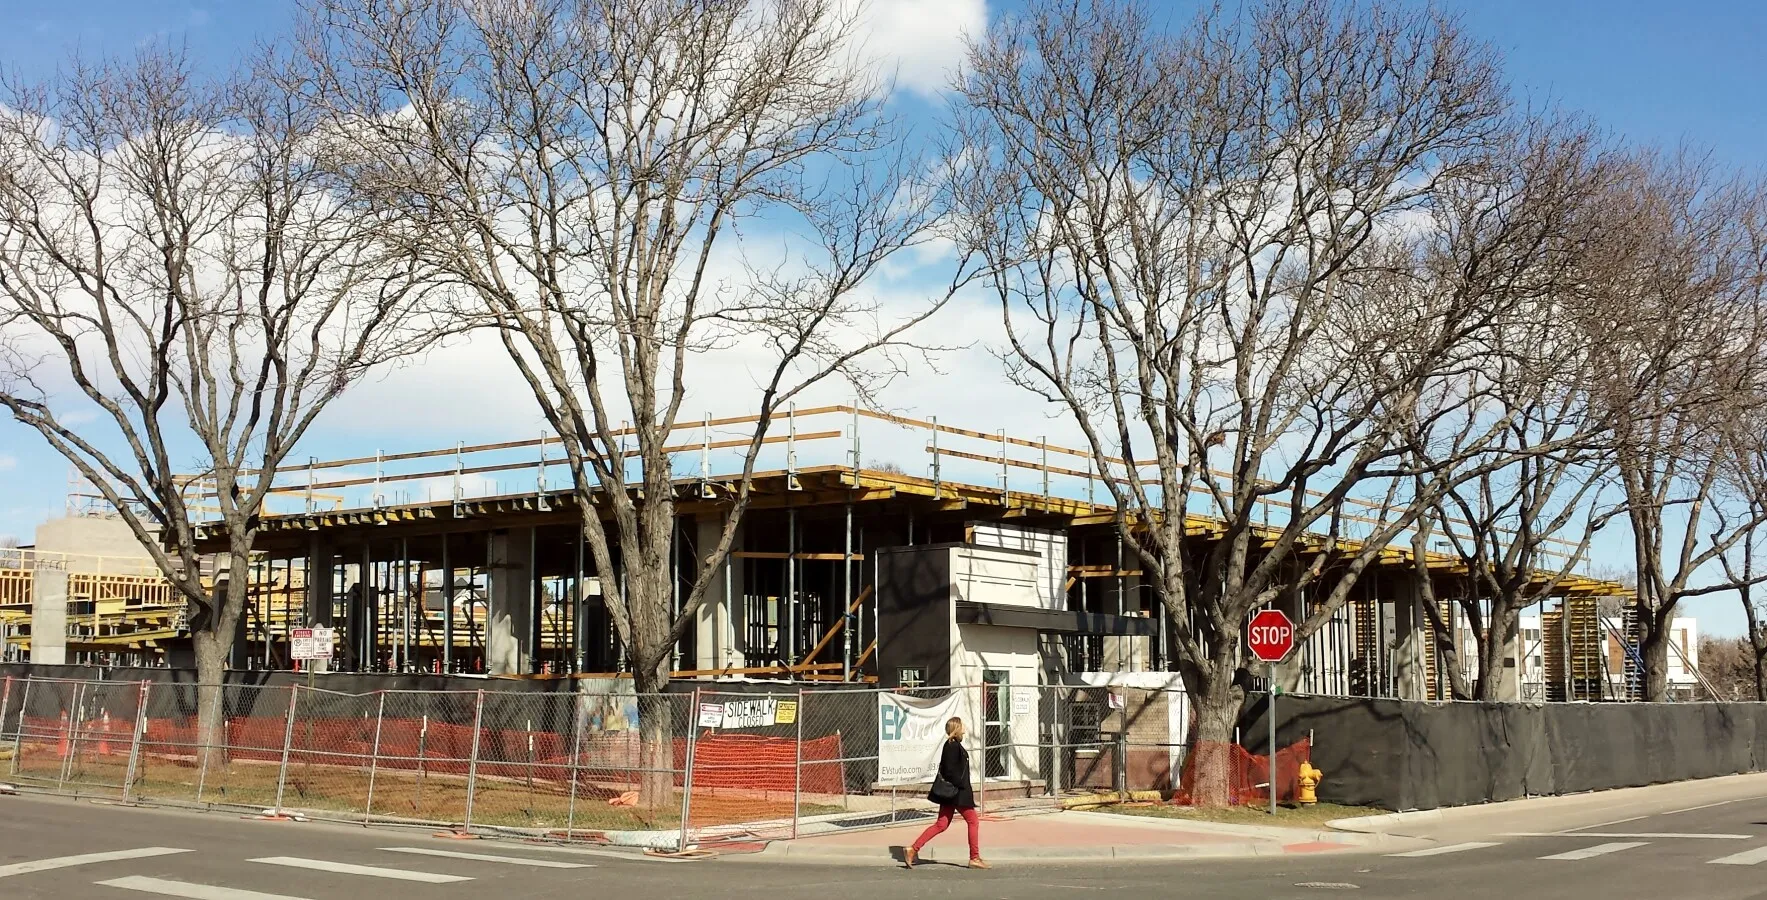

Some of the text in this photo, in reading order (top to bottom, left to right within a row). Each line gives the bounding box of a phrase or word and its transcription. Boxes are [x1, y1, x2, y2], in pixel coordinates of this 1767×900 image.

[1251, 626, 1290, 645] STOP
[727, 700, 774, 718] SIDEWALK
[738, 715, 764, 728] CLOSED
[881, 766, 922, 774] EVstudio.com
